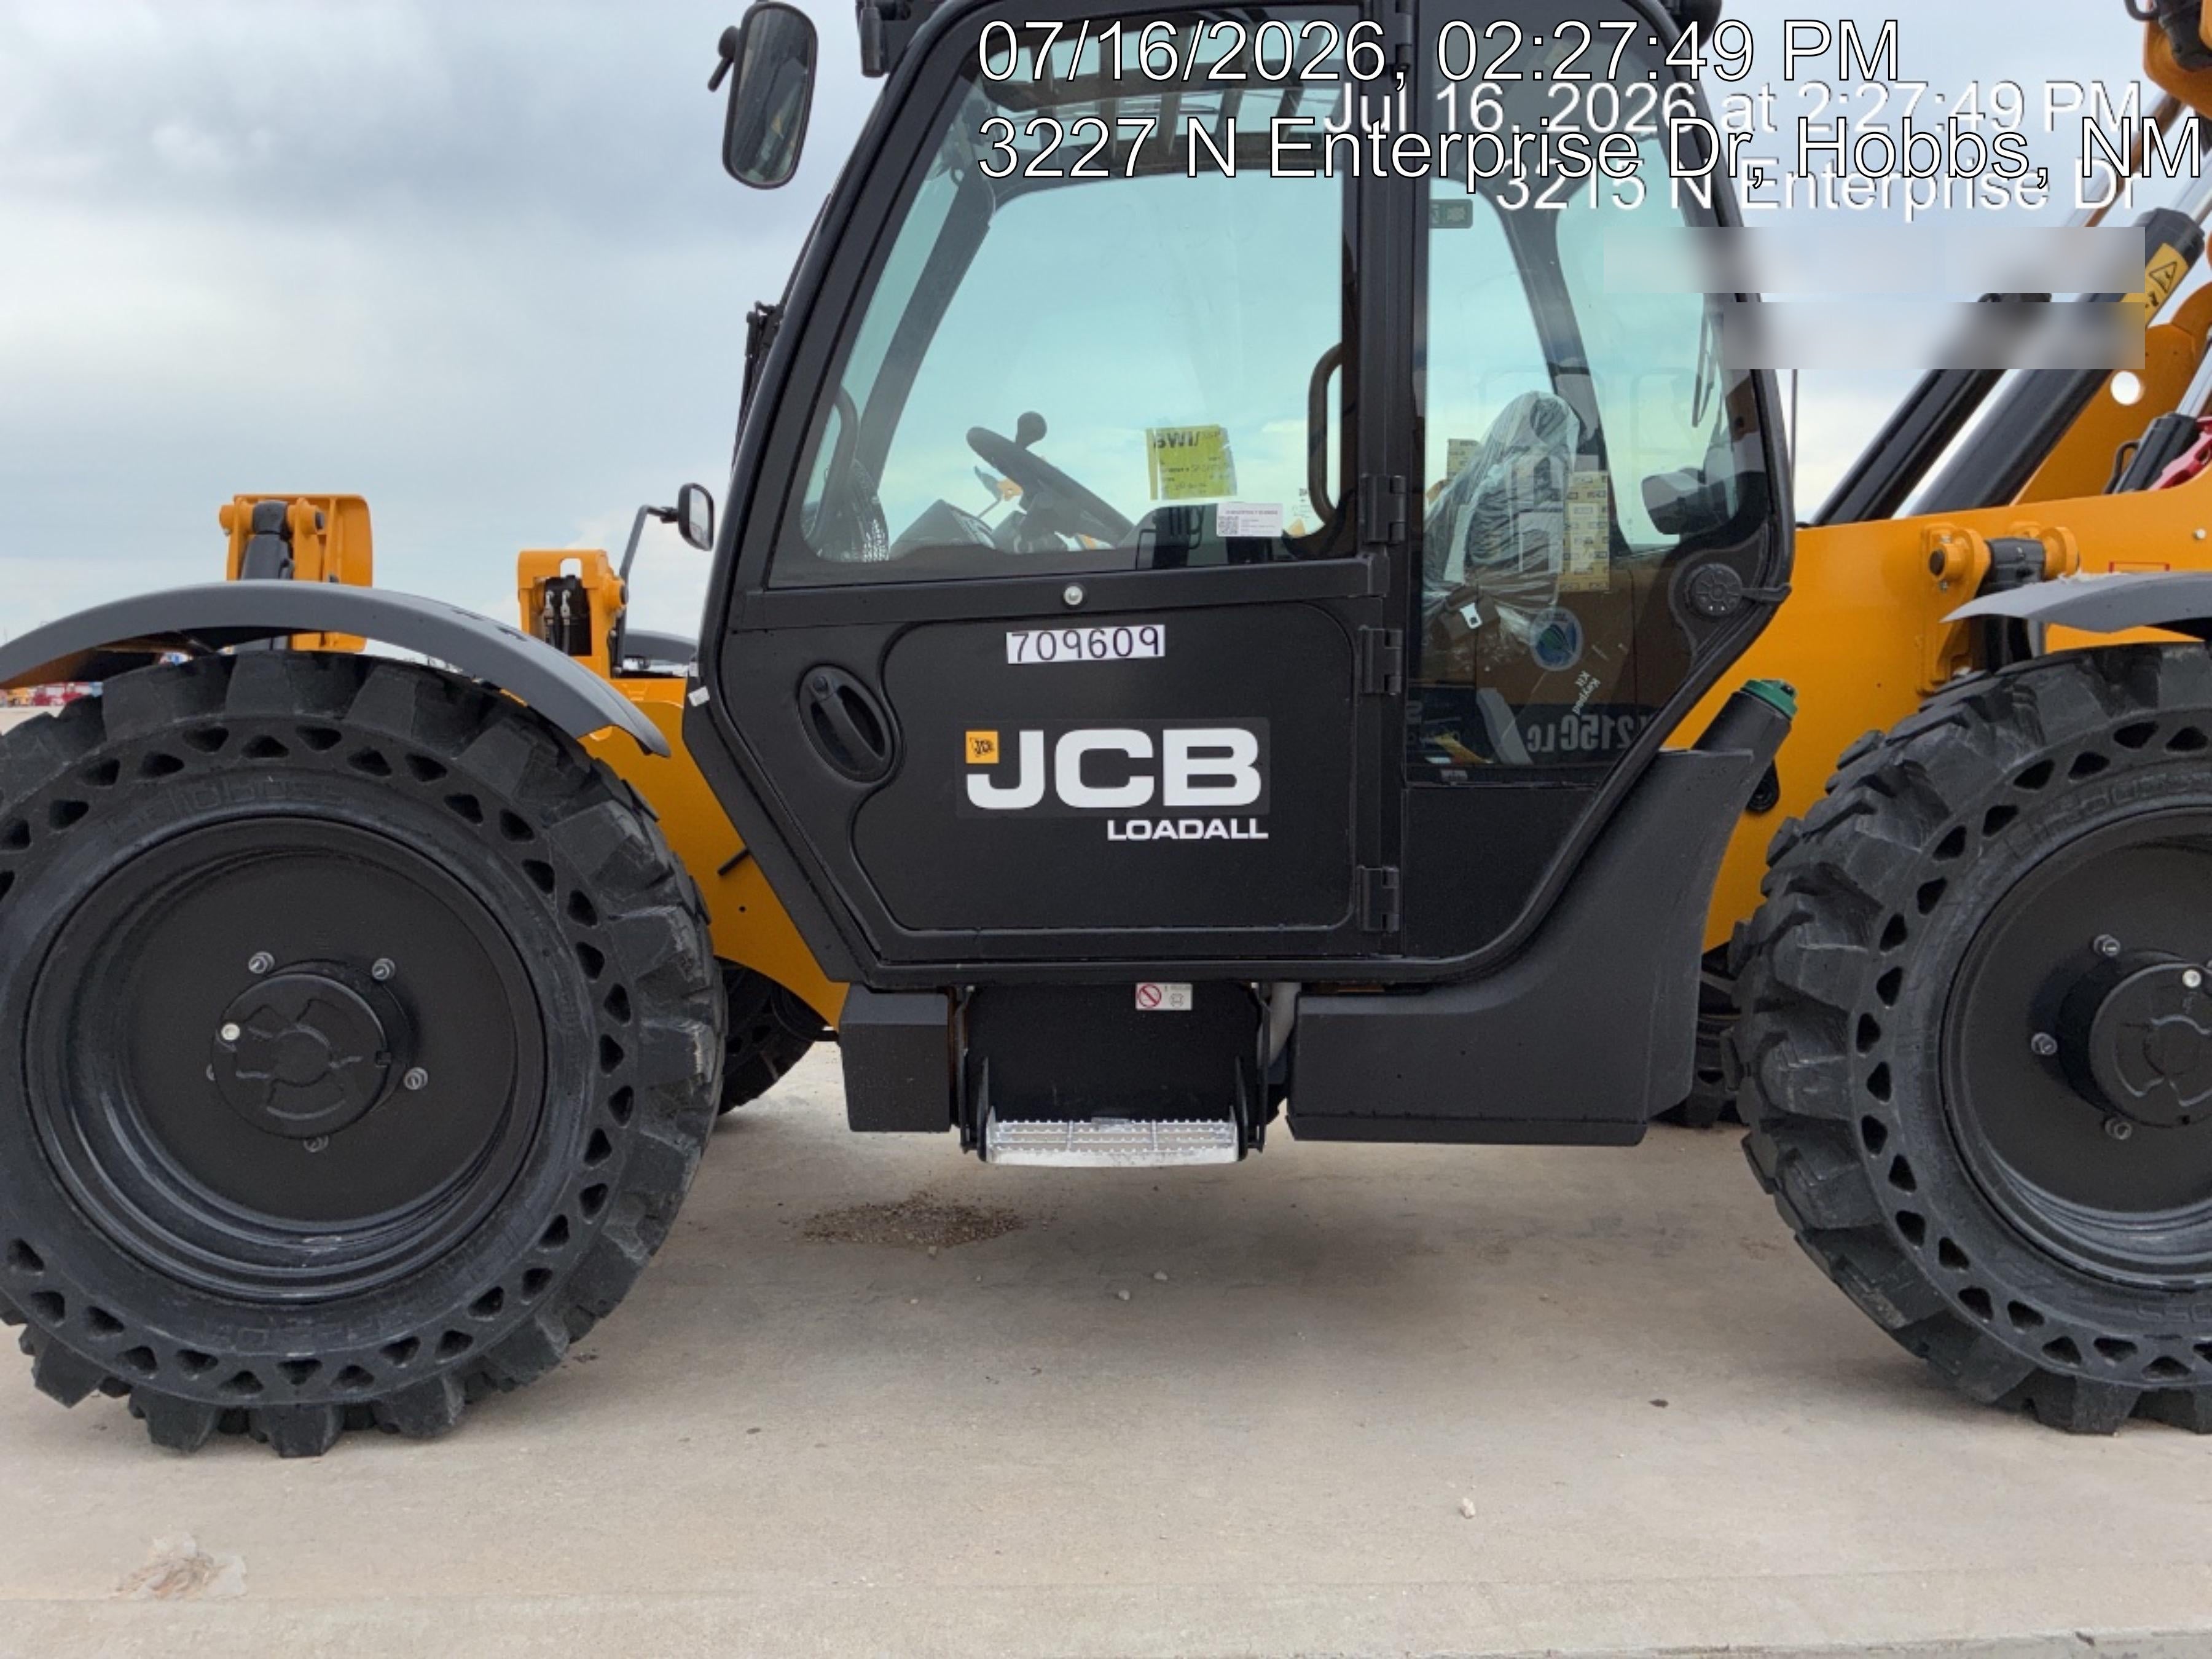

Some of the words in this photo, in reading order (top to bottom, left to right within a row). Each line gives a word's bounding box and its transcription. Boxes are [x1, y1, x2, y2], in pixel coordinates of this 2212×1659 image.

[1011, 626, 1161, 662] 709609
[967, 728, 1261, 810] JCB
[1107, 818, 1269, 841] LOADALL
